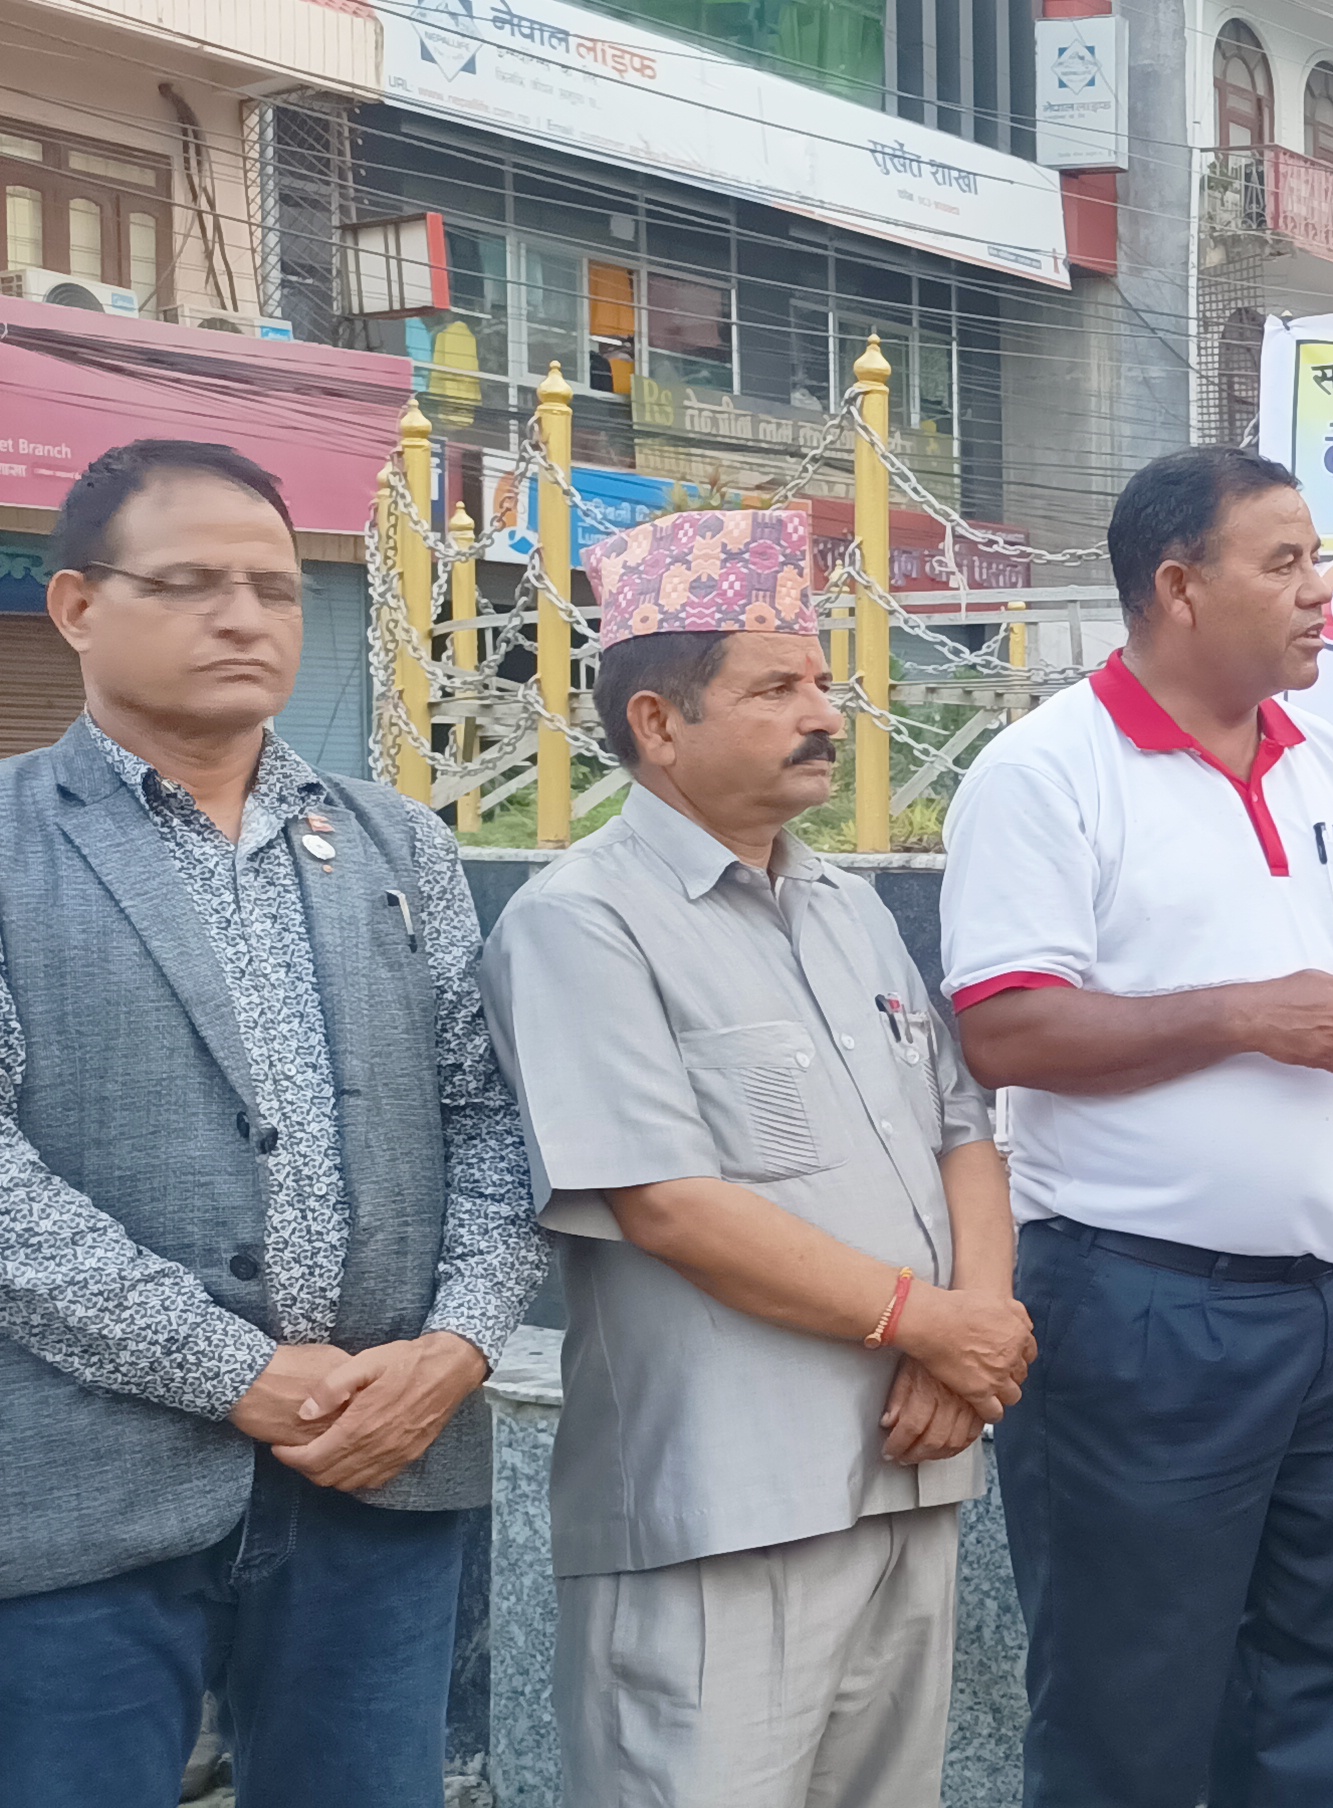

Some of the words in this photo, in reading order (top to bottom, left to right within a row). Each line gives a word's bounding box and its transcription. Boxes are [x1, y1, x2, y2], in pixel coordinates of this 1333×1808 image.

[490, 0, 570, 54] नेपाल
[929, 159, 978, 195] शाखा
[19, 438, 71, 459] Branch
